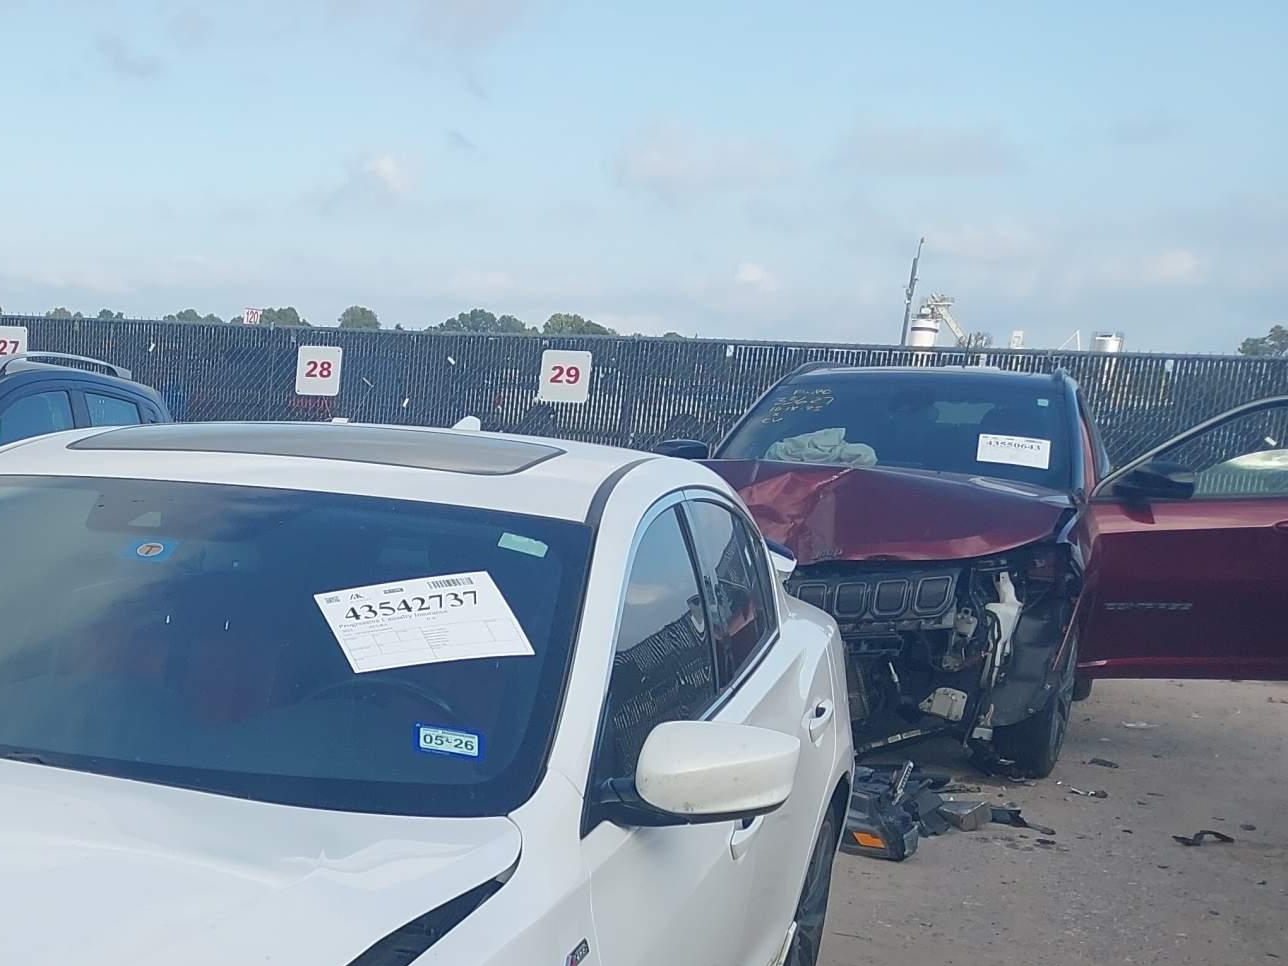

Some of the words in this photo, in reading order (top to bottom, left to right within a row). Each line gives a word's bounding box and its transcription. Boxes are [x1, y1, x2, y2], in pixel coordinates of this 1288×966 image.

[305, 360, 332, 378] 28
[549, 365, 580, 385] 29
[344, 590, 478, 621] 43542737
[423, 733, 444, 746] 05
[453, 738, 474, 751] 26
